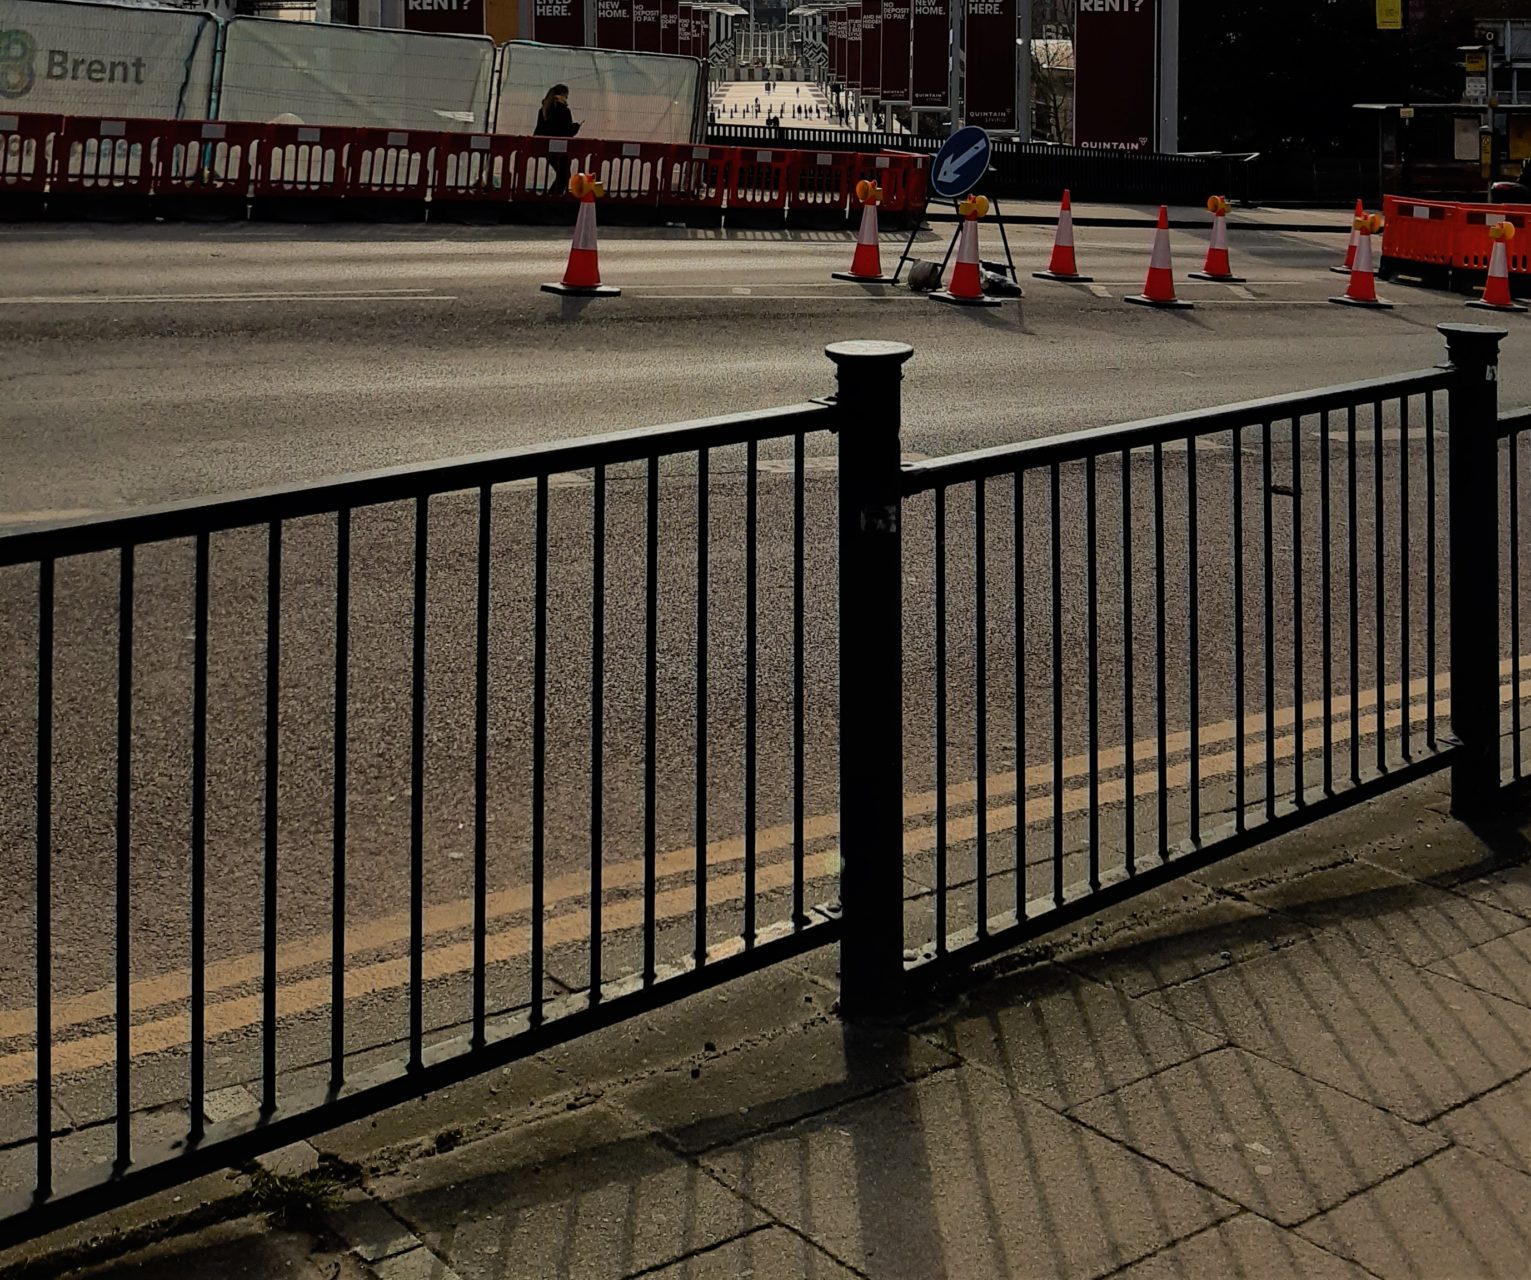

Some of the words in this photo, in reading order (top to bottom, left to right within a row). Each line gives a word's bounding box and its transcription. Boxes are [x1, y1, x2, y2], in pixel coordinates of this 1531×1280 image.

[536, 5, 571, 16] HERE.
[598, 1, 620, 10] NEW
[915, 6, 946, 15] HOME.
[969, 3, 1003, 14] HERE.
[598, 9, 630, 18] HOME.
[47, 49, 147, 84] Brent
[1081, 140, 1140, 150] QUINTAIN
